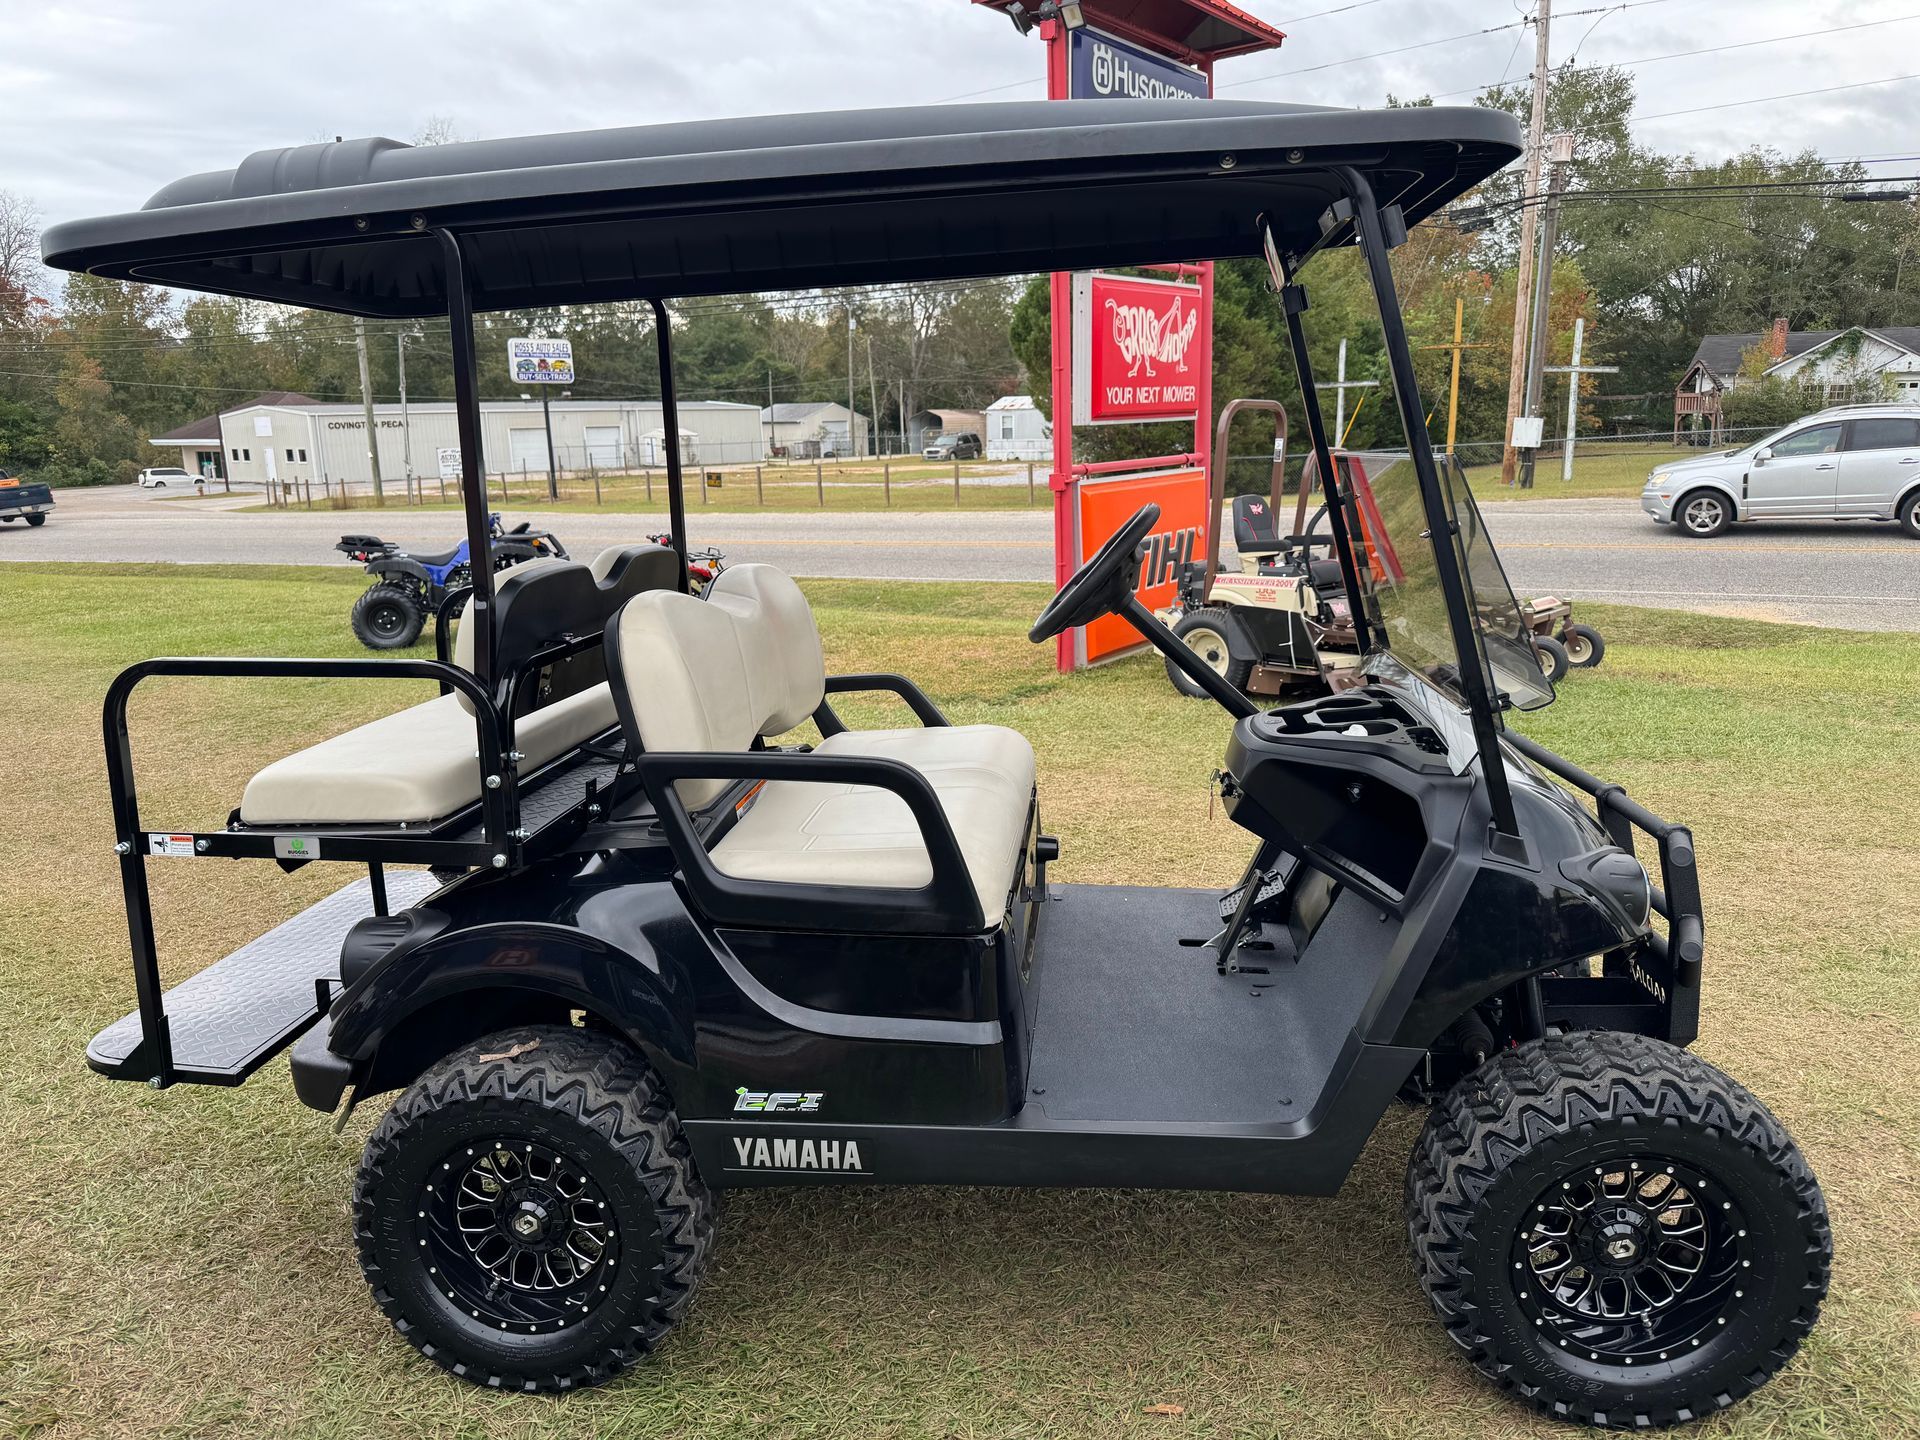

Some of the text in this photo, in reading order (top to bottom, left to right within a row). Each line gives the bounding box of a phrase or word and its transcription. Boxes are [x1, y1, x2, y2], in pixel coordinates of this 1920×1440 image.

[536, 343, 551, 353] AUTO
[552, 343, 569, 353] SALES
[1105, 385, 1196, 405] YOUR NEXT MOWER
[327, 420, 379, 430] COVINGTN
[733, 1091, 824, 1112] EFI
[733, 1137, 862, 1170] YAMAHA
